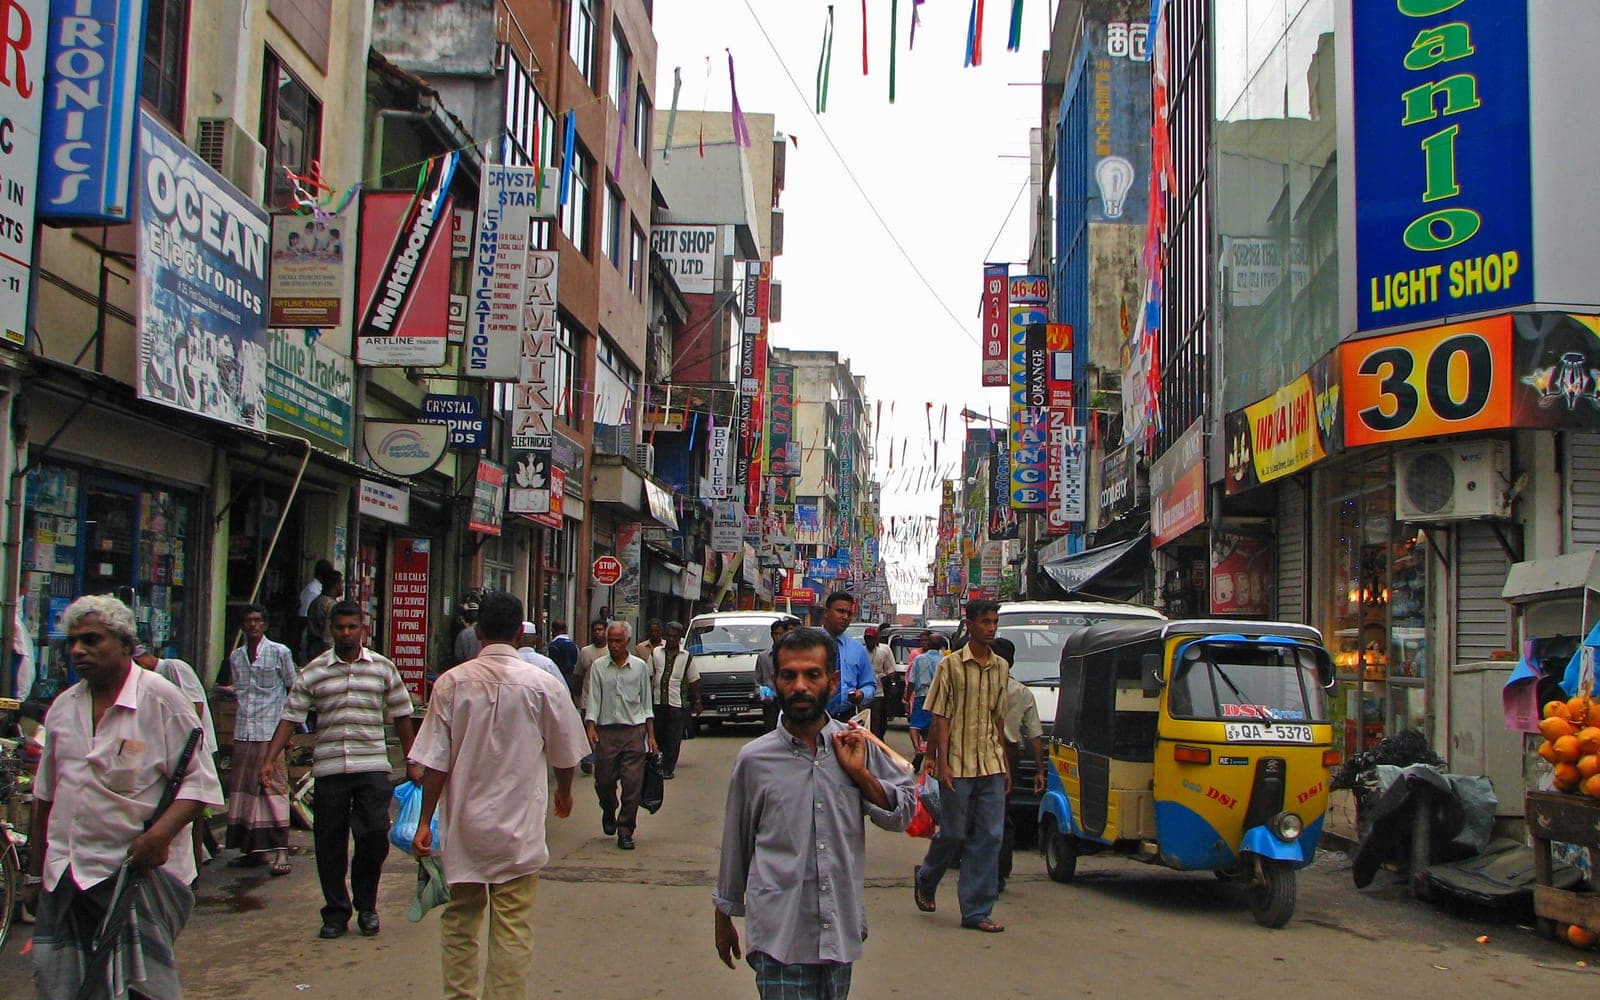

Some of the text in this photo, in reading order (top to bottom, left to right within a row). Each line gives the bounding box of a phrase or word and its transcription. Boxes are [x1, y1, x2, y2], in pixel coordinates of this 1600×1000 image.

[51, 0, 105, 204] RONICS
[499, 192, 536, 207] STAR
[146, 155, 265, 280] OCEAN
[679, 231, 715, 253] SHOP
[149, 223, 263, 315] Electronics
[371, 199, 434, 332] Multibond
[680, 259, 703, 275] LTD
[470, 210, 499, 369] COMMUNICATIONS
[1371, 250, 1518, 312] LIGHT SHOP
[746, 277, 756, 316] ORANGE
[365, 337, 414, 345] ARTLINE
[517, 254, 557, 436] DAMMIKA
[743, 335, 752, 376] ORANGE
[1032, 349, 1044, 406] ORANGE
[1358, 333, 1493, 431] 30
[426, 400, 474, 414] CRYSTAL
[417, 419, 482, 431] DING
[512, 437, 552, 447] ELECTRICALS
[712, 429, 725, 496] BENTLEY
[408, 573, 427, 581] CALLS
[393, 584, 427, 594] LOCAL CALLS
[392, 609, 425, 618] PHOTO COPY
[397, 621, 420, 630] TYPING
[1222, 704, 1267, 717] DSI
[1242, 725, 1262, 738] QA
[1276, 726, 1312, 741] 5378
[1205, 787, 1238, 810] DSI
[1297, 782, 1323, 804] DSI
